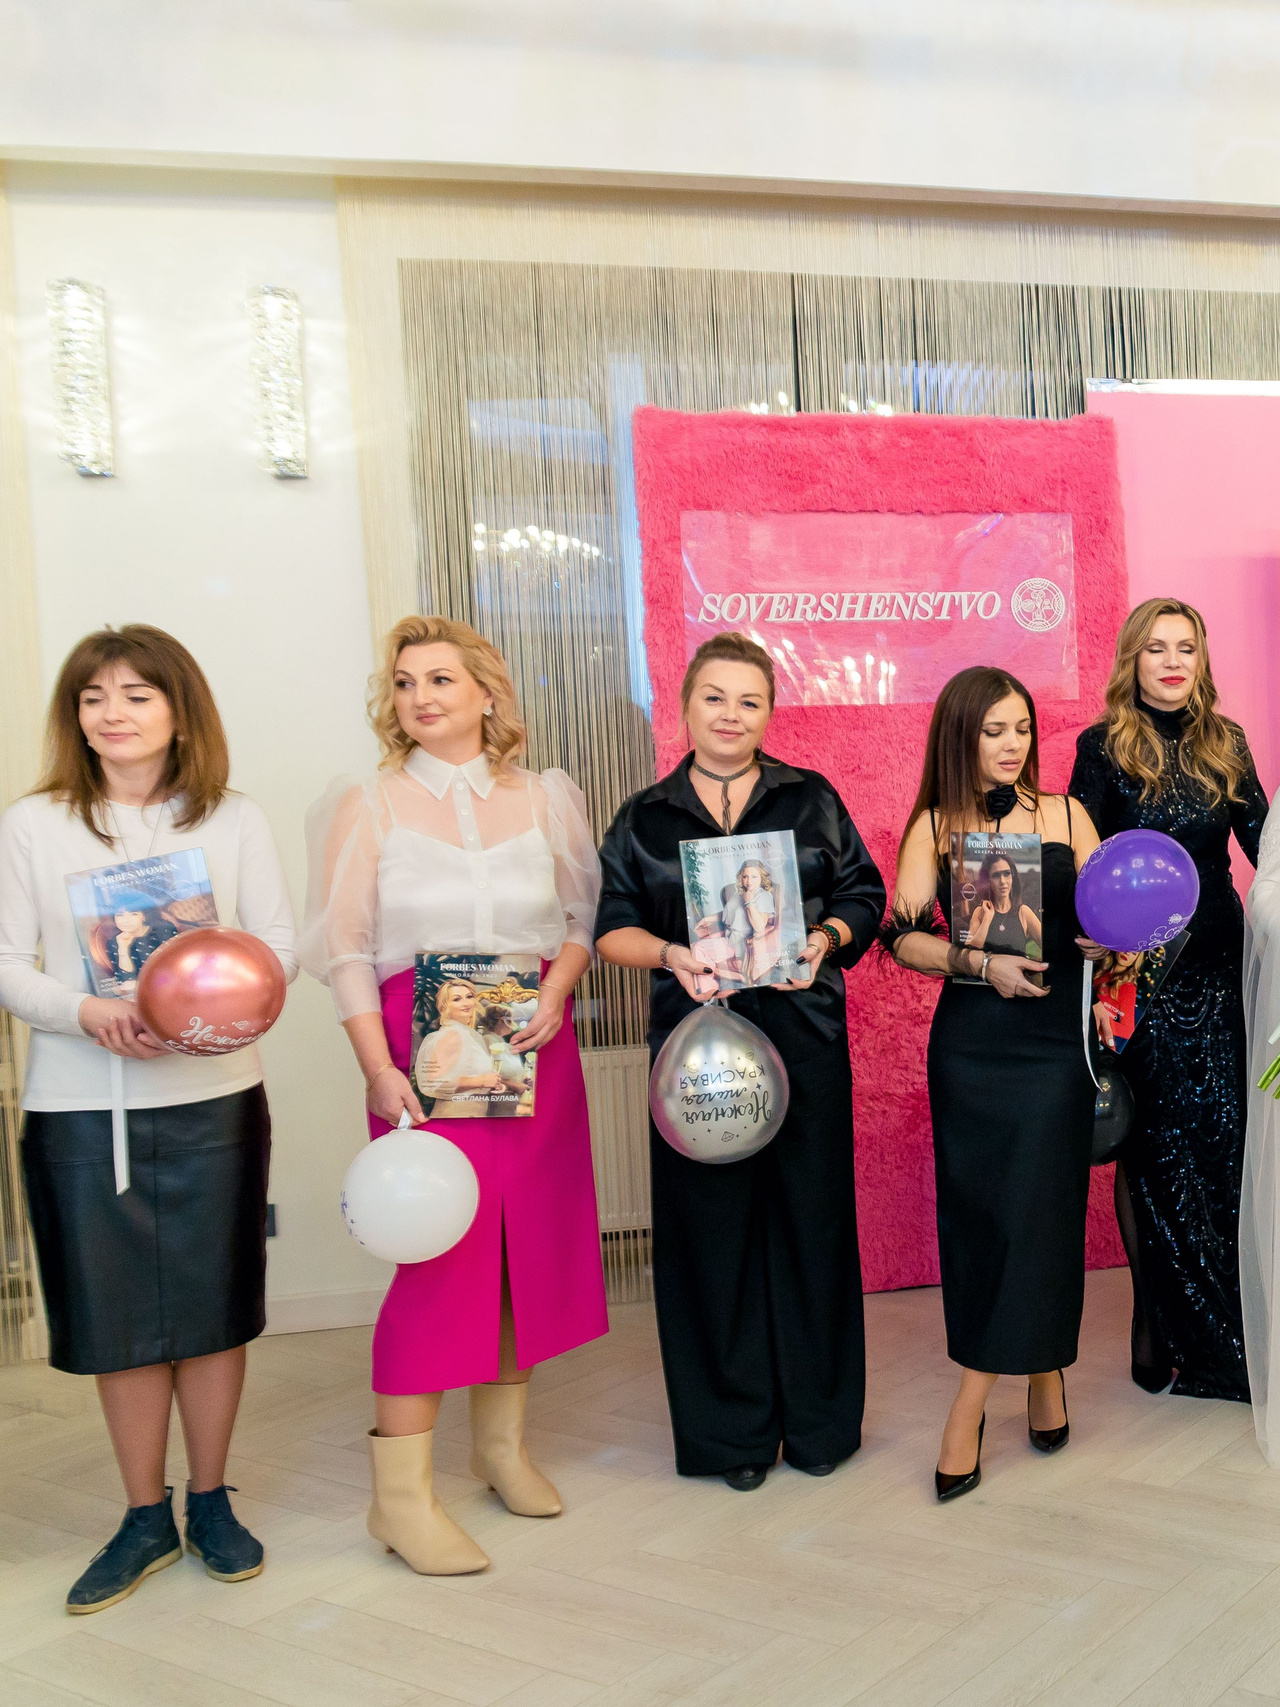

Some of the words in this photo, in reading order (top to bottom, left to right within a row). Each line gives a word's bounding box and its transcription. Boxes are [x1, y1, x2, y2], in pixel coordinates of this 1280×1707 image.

[698, 591, 1001, 623] SOVERSHENSTVO
[703, 844, 736, 855] FORBES
[738, 840, 772, 850] WOMAN
[967, 840, 994, 849] FORBES
[994, 841, 1022, 849] WOMAN
[93, 869, 138, 886] FORBES
[136, 862, 180, 877] WOMAN
[440, 963, 479, 972] FORBES
[479, 963, 517, 972] WOMAN
[680, 1064, 766, 1090] КРАСИВАЯ
[681, 1086, 748, 1106] милая
[682, 1090, 772, 1125] Нежная
